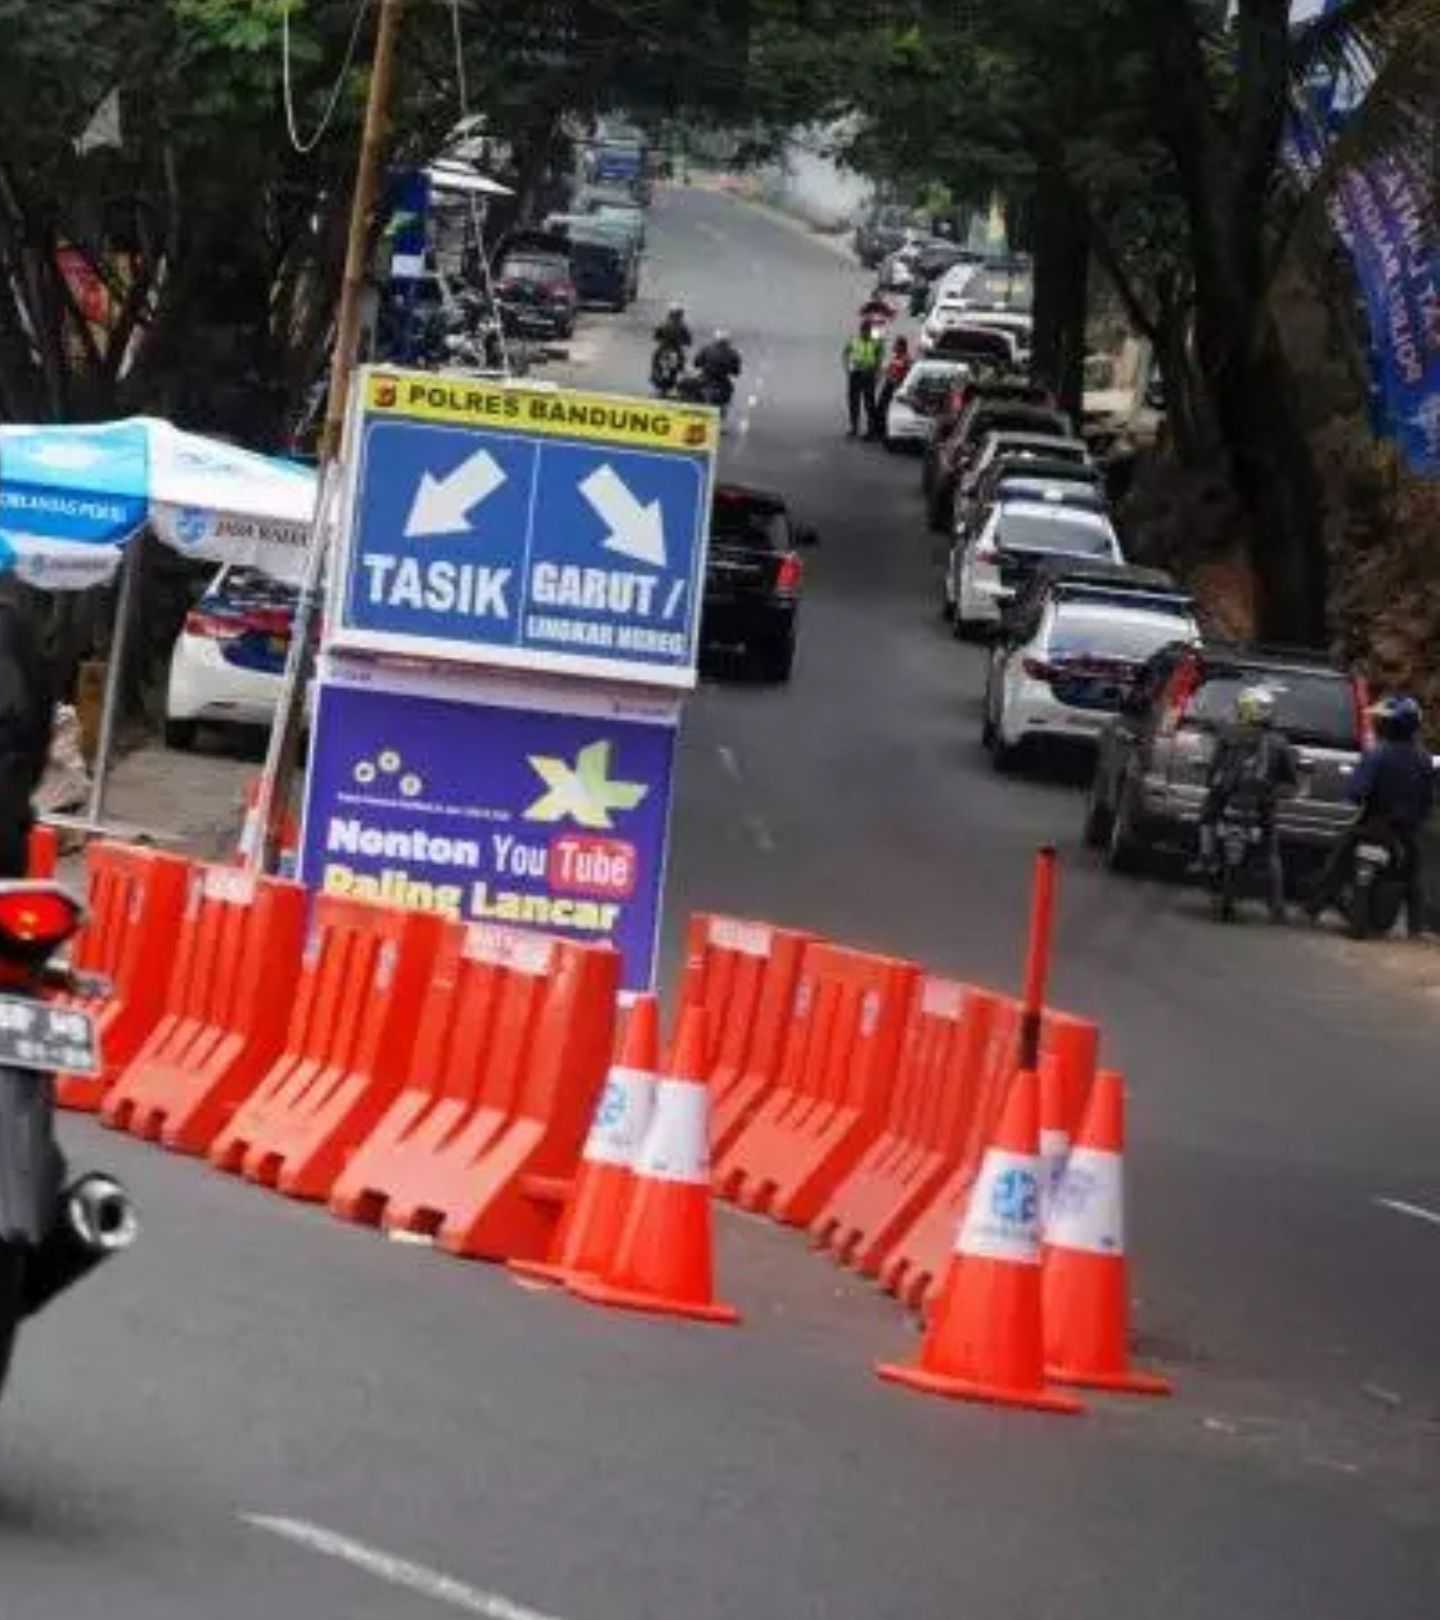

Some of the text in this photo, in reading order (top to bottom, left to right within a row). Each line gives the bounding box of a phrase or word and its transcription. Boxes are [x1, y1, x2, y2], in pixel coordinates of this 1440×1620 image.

[409, 384, 671, 436] POLRES BANDUNG
[362, 553, 512, 619] TASIK
[532, 561, 685, 619] GARUT /
[326, 817, 479, 868] Nonton
[471, 881, 620, 930] Lancar
